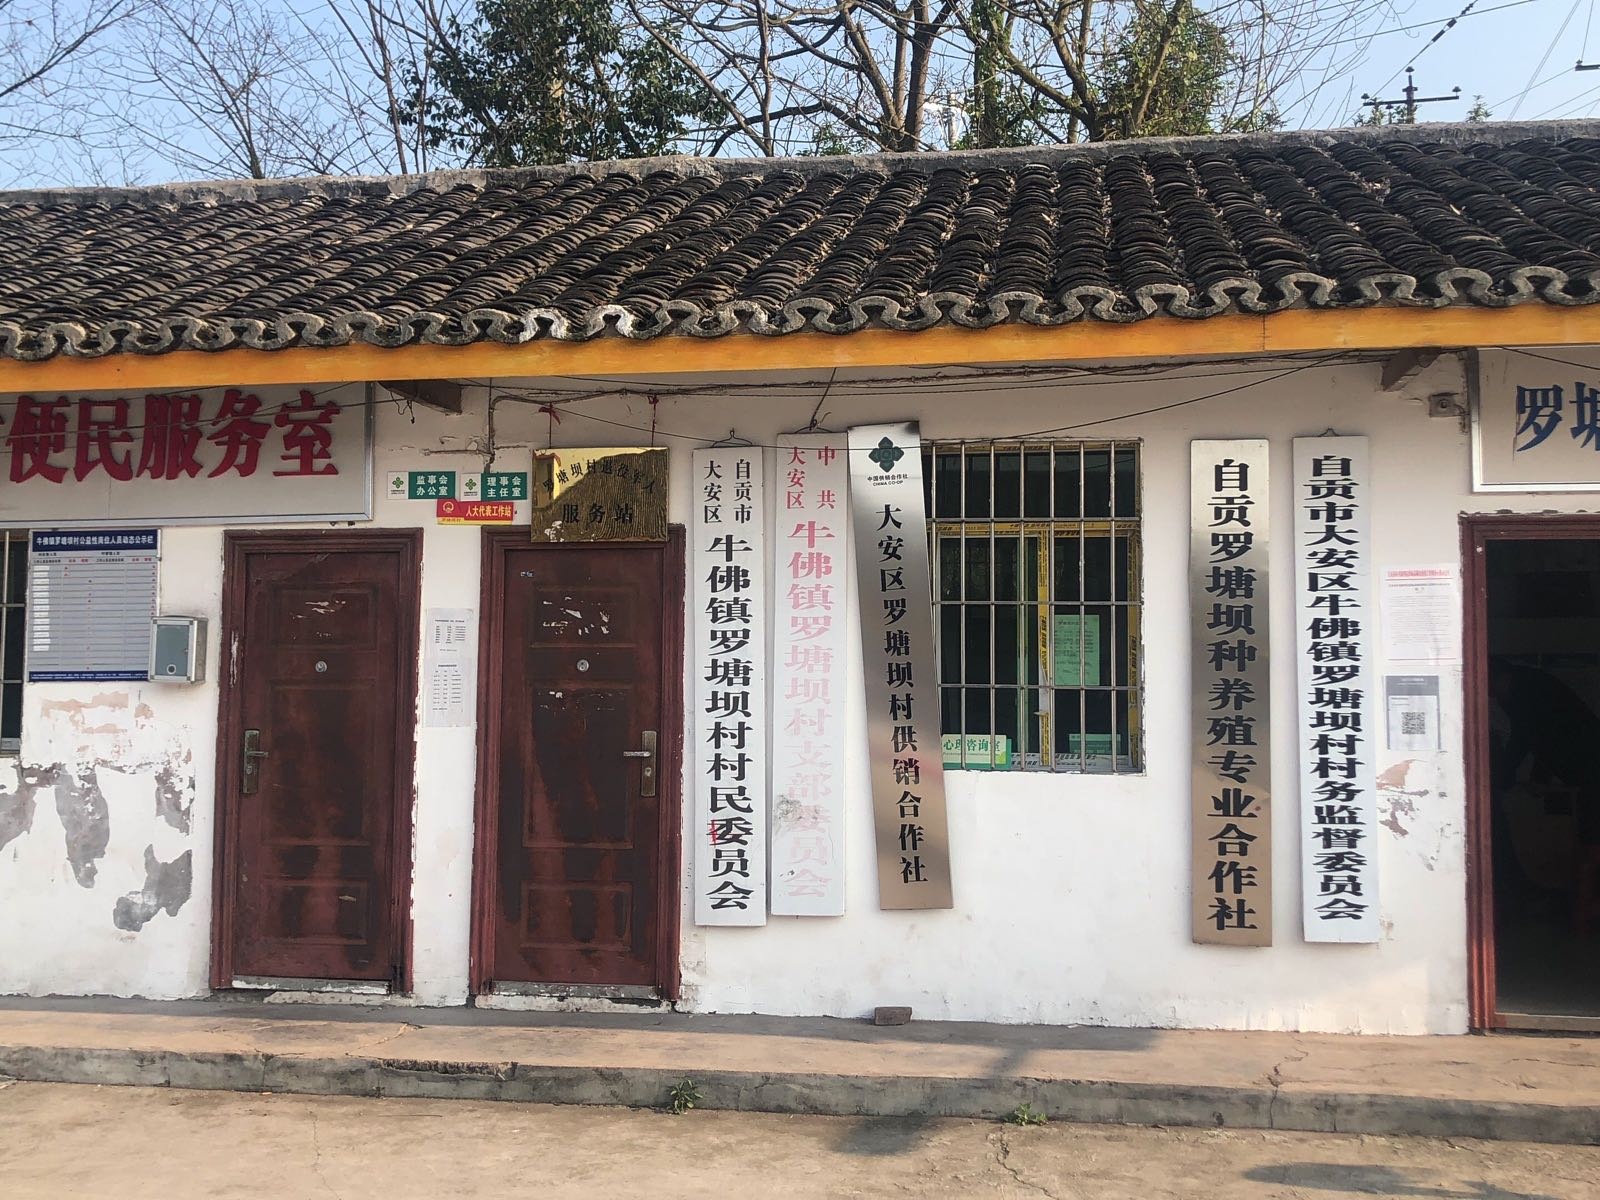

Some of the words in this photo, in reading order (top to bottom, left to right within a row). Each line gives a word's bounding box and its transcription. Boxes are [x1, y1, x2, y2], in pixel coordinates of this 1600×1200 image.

[0, 388, 341, 484] 便民服务室
[416, 474, 448, 485] 监事会
[416, 486, 448, 496] 办公室
[487, 476, 521, 487] 理事会
[487, 487, 521, 498] 主任室
[703, 460, 722, 524] 大安区
[733, 458, 753, 524] 自贡市
[787, 446, 806, 510] 大安区
[817, 446, 836, 509] 中共
[867, 473, 908, 481] 中国供销合作社
[466, 505, 512, 517] 人大代表工作站
[562, 502, 633, 525] 服务站
[876, 503, 928, 884] 大安区罗塘坝村供销合作社
[1205, 458, 1257, 930] 自贡罗塘坝种养殖专业合作社
[1302, 455, 1369, 920] 自贡市大安区牛佛镇罗塘坝村村务监督委员会
[703, 534, 755, 910] 牛佛镇罗塘坝村村民委员会
